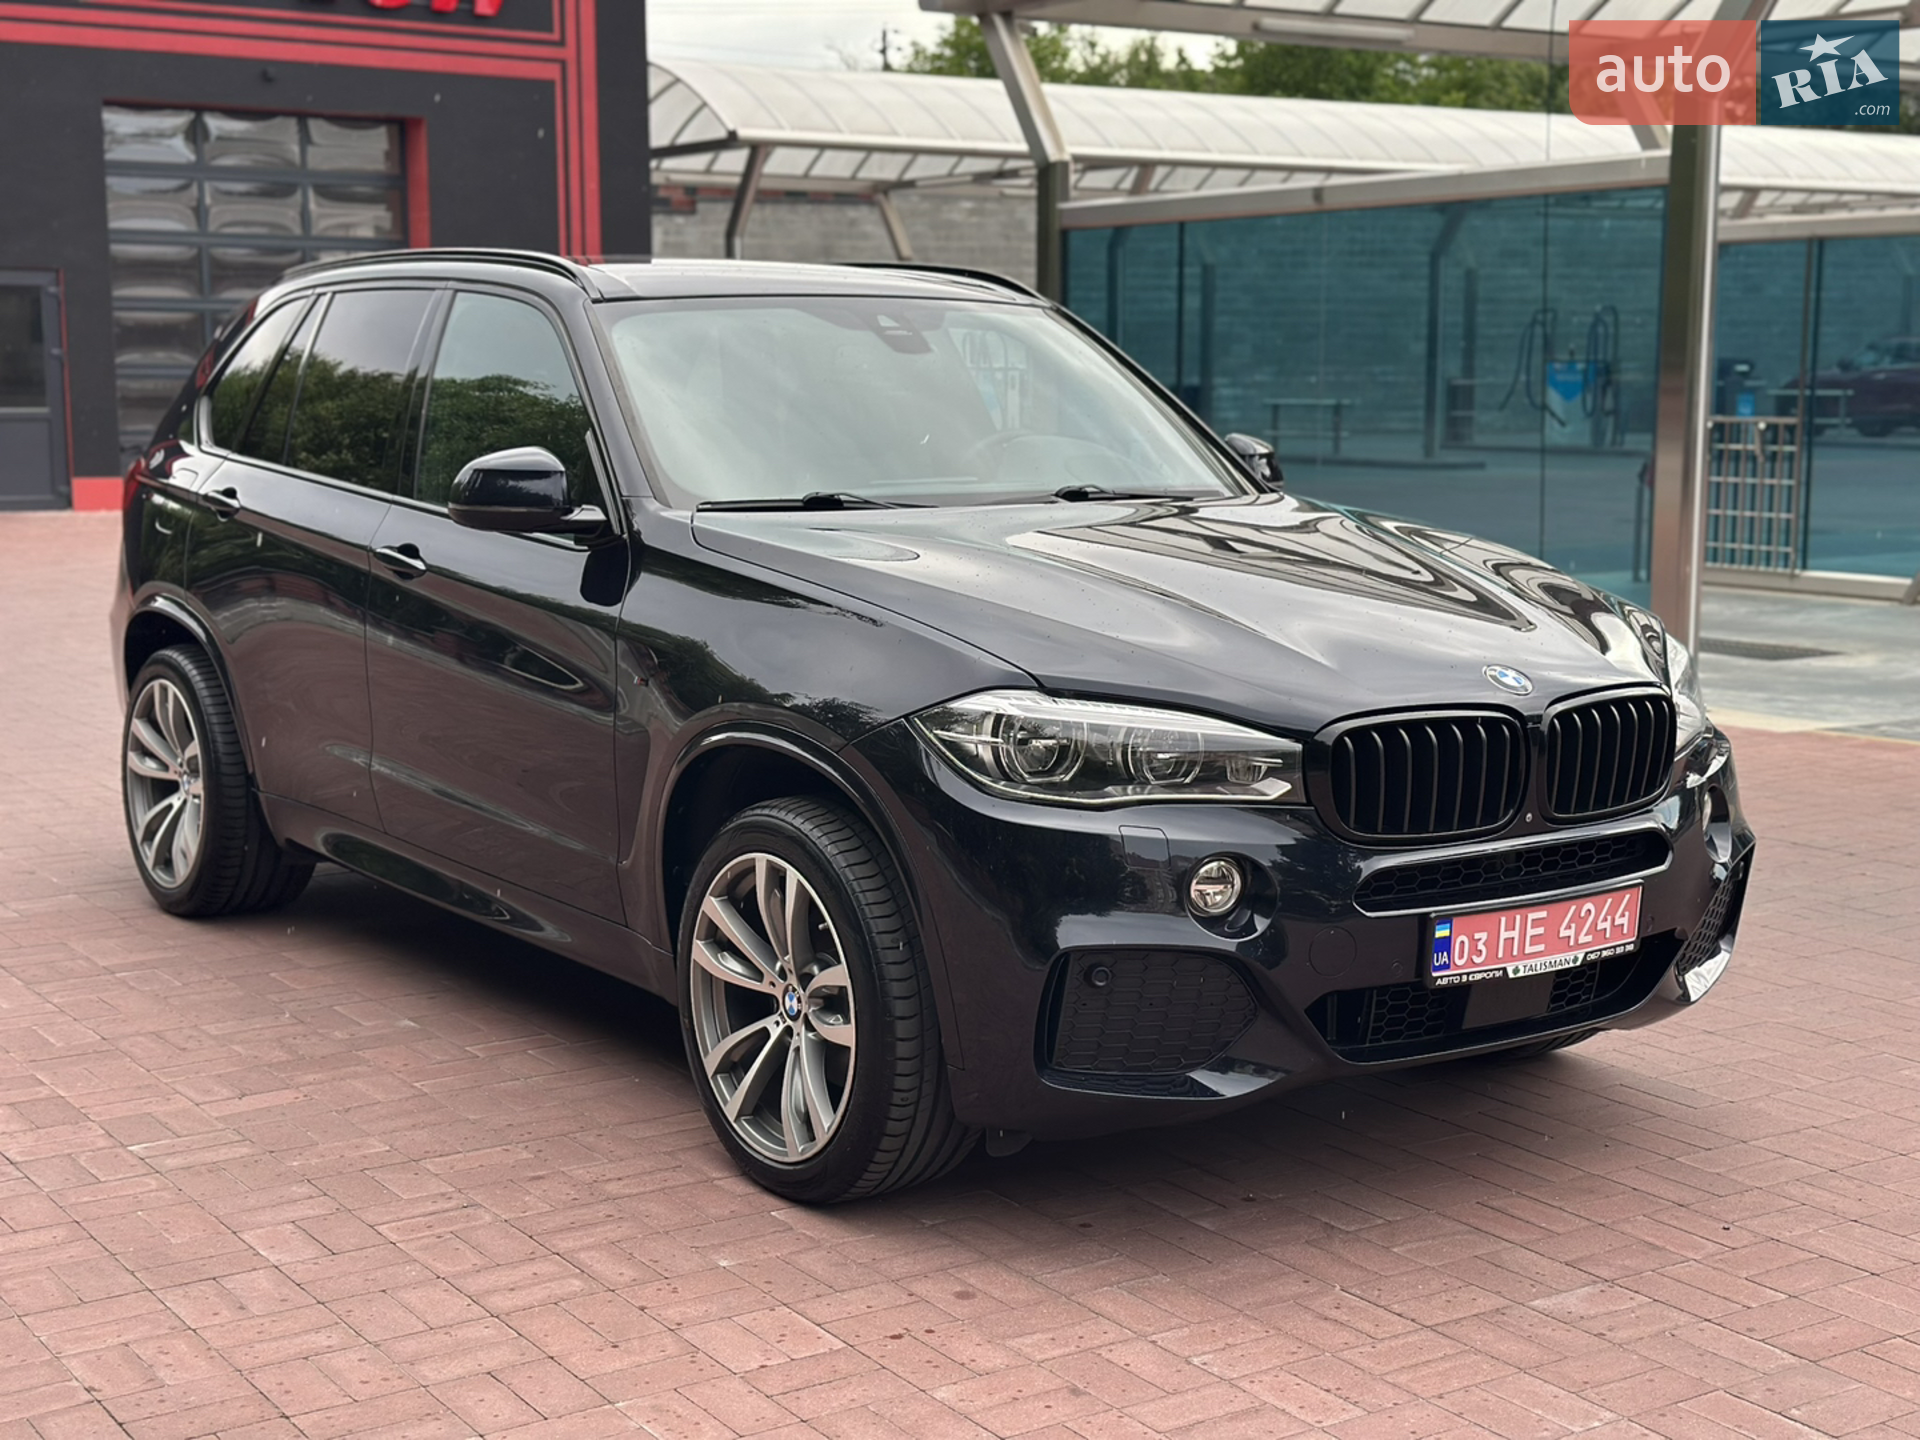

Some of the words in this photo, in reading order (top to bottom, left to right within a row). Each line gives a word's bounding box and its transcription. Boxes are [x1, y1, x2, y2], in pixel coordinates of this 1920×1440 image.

[1453, 932, 1488, 966] 03
[1497, 911, 1547, 959] HE
[1559, 894, 1631, 946] 4244
[1434, 951, 1449, 966] UA
[1522, 957, 1571, 974] TALISMAN
